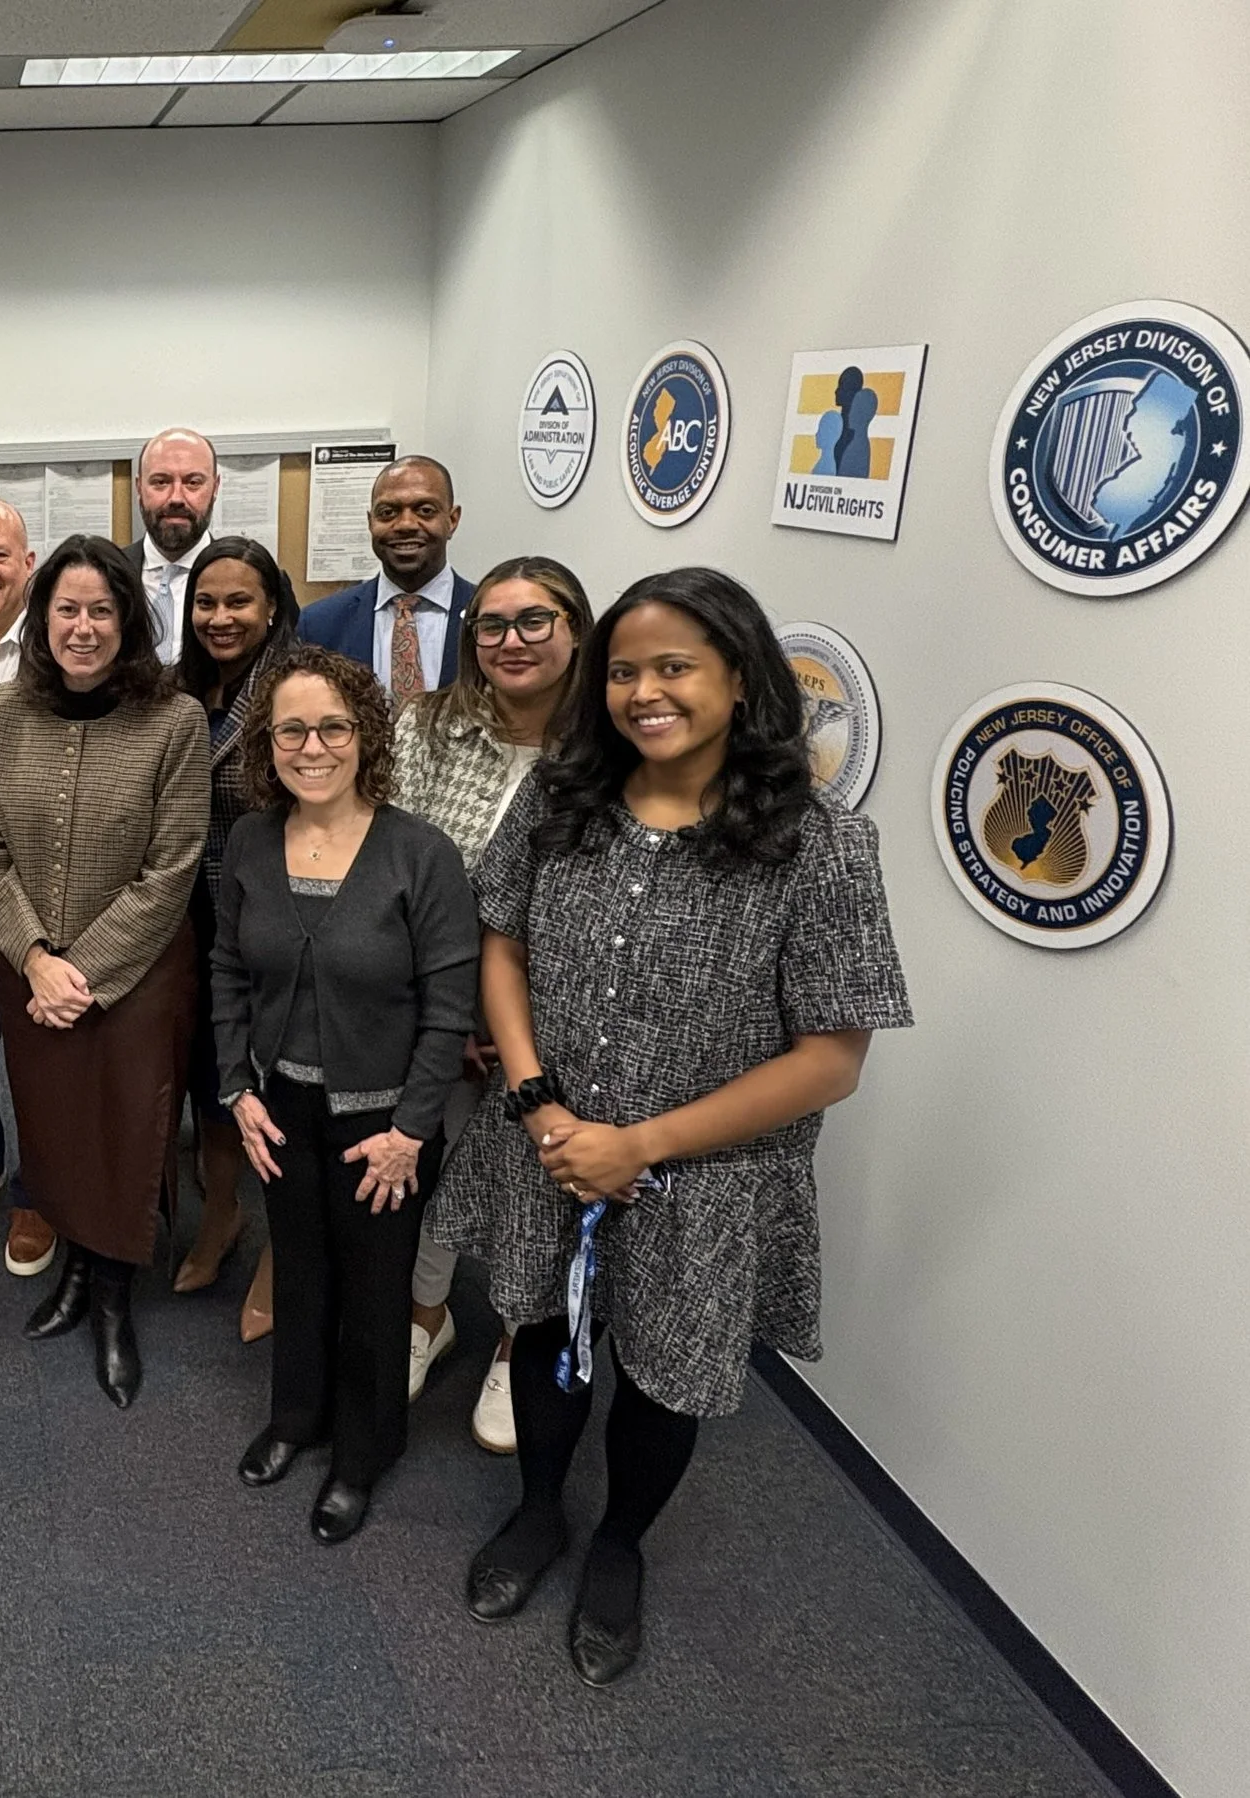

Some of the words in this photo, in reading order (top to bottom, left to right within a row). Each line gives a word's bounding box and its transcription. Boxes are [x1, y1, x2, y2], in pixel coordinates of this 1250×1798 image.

[642, 380, 656, 399] NEW
[656, 360, 678, 381] JERSEY
[678, 360, 705, 382] DIVISION
[702, 381, 712, 396] OF
[1025, 371, 1062, 418] NEW
[1064, 330, 1132, 377] JERSEY
[1135, 329, 1217, 387] DIVISION
[1206, 386, 1230, 417] OF
[524, 430, 584, 444] ADMINISTRATION
[539, 421, 560, 430] DIVISION
[561, 421, 569, 430] OF
[656, 419, 702, 453] ABC
[629, 413, 646, 496] ALCOHOLIC
[645, 486, 692, 509] BEVERAGE
[691, 414, 717, 490] CONTROL
[809, 485, 833, 495] DIVISION
[834, 487, 842, 495] ON
[784, 482, 807, 510] NJ
[806, 494, 835, 513] CIVIL
[836, 497, 884, 519] RIGHTS
[1009, 467, 1106, 570] CONSUMER
[1115, 478, 1218, 569] AFFAIRS
[843, 715, 860, 777] STANDARDS
[975, 716, 1007, 746] NEW
[1011, 709, 1067, 727] JERSEY
[1070, 719, 1118, 765] OFFICE
[1113, 766, 1133, 790] OF
[950, 746, 977, 835] POLICING
[958, 840, 1031, 916] STRATEGY
[1083, 799, 1141, 915] INNOVATION
[1036, 903, 1078, 922] AND
